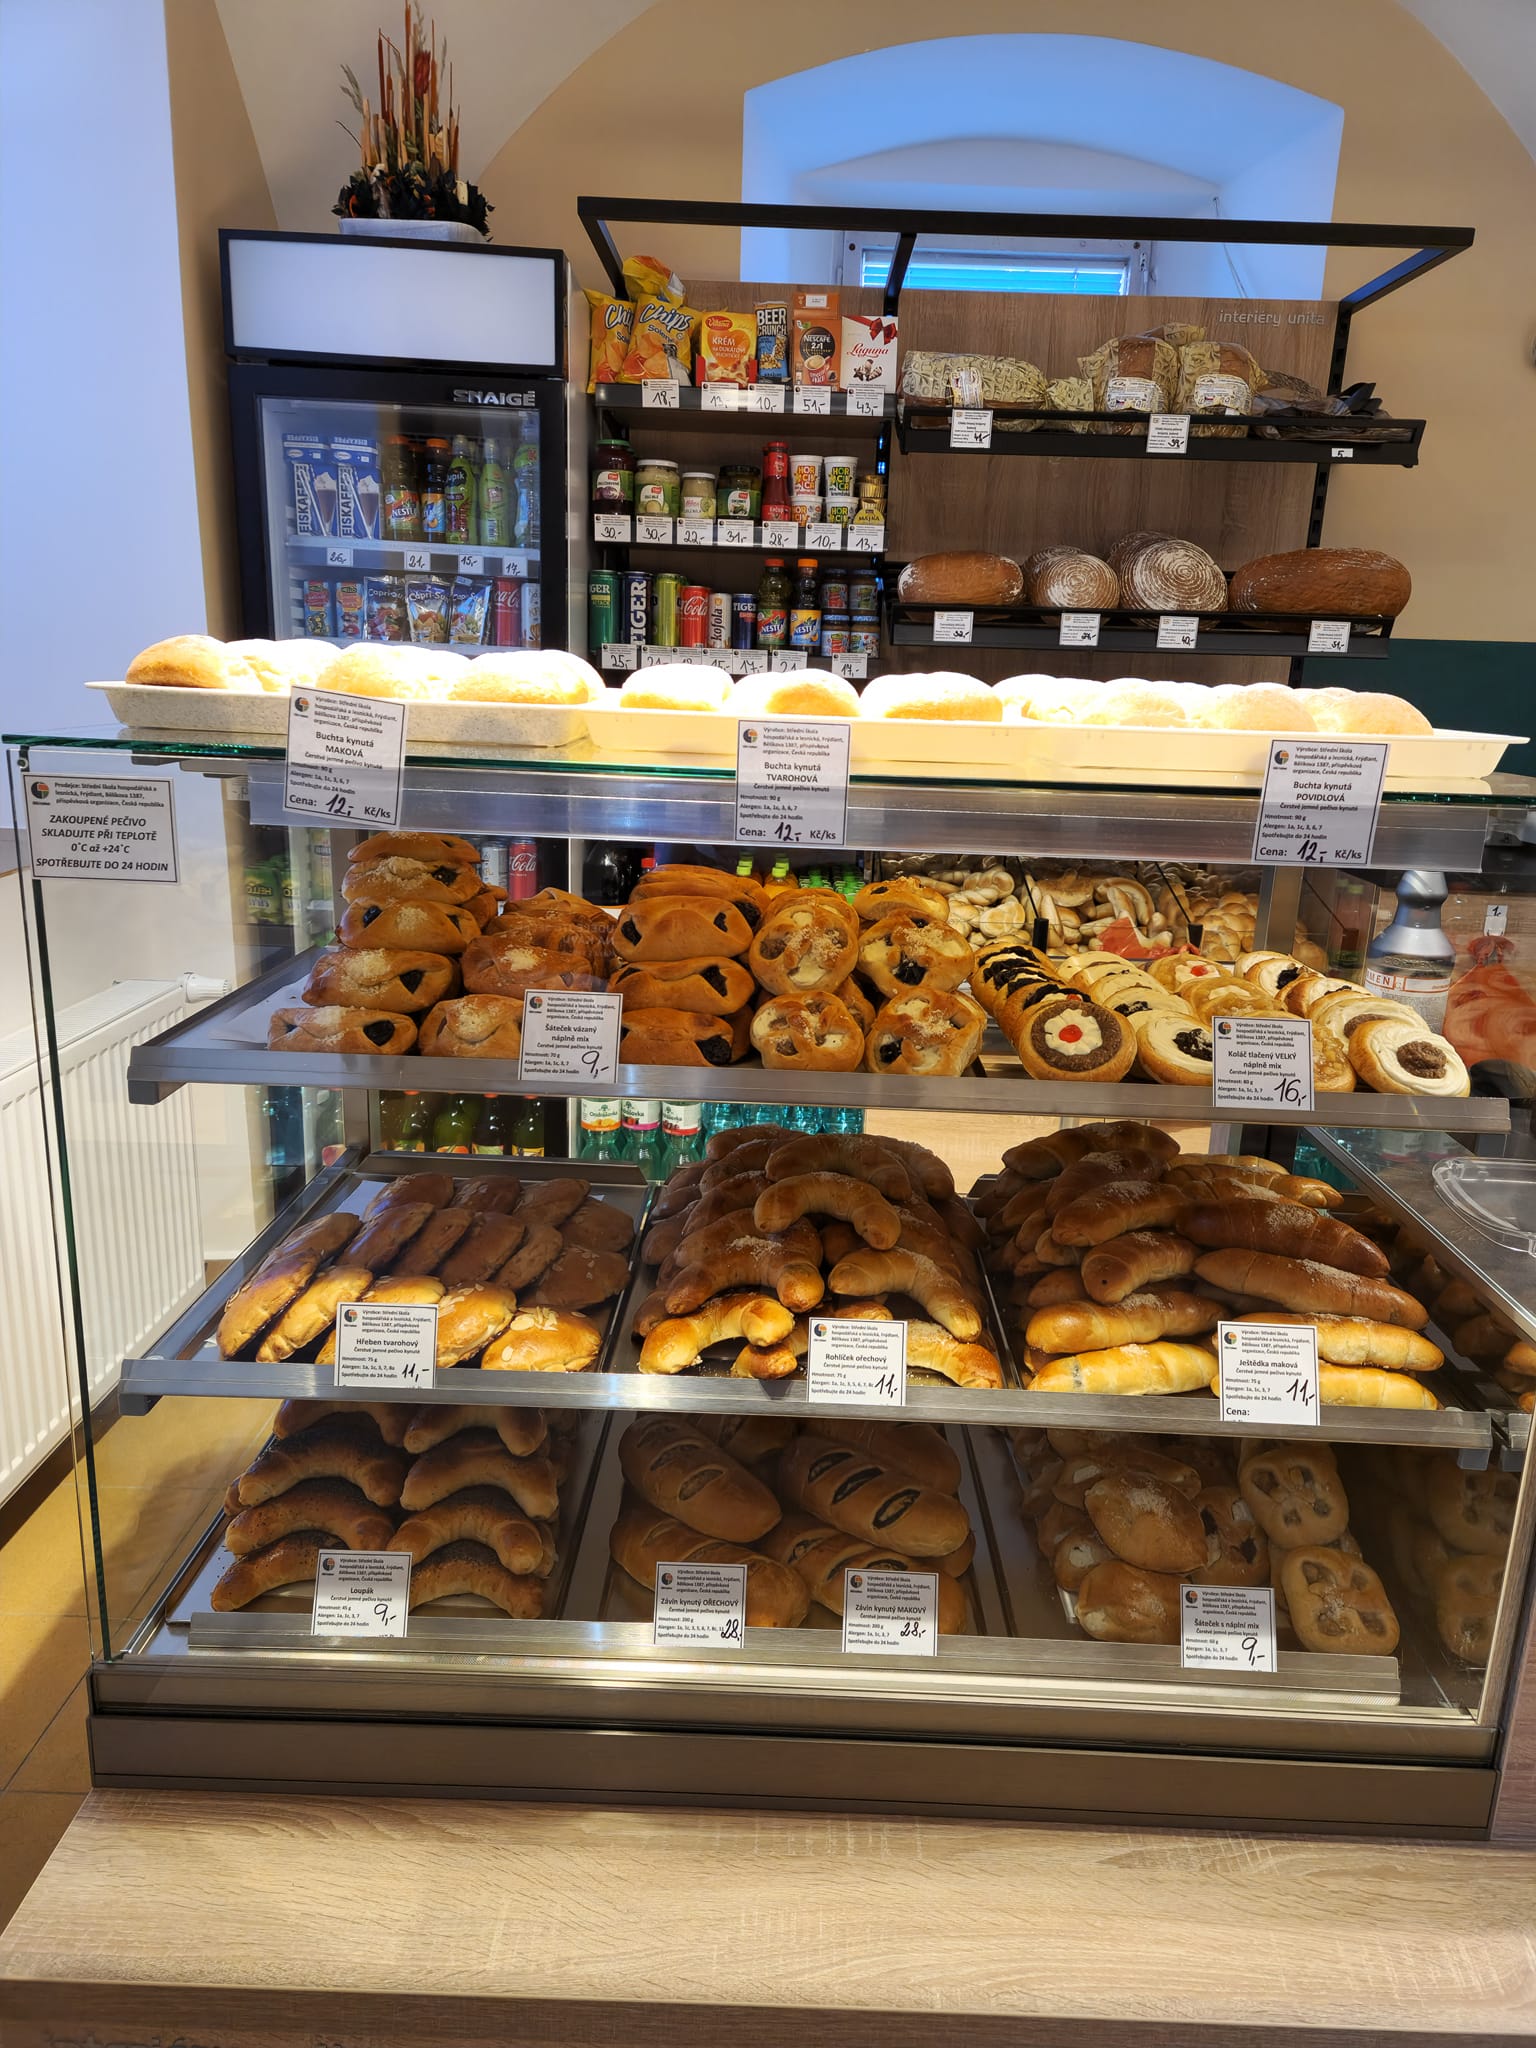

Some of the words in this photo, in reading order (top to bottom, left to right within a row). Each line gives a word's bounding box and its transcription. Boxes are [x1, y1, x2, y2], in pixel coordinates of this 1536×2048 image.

[640, 304, 694, 332] Chips
[757, 308, 786, 325] BEER
[1219, 310, 1280, 326] interiéry
[1288, 313, 1324, 324] unita
[758, 325, 786, 336] CRUNCH
[712, 336, 736, 346] KRÉM
[847, 343, 889, 357] Laguna
[803, 399, 826, 413] 51,-
[856, 401, 878, 416] 43,-
[769, 533, 789, 547] 28,-
[812, 535, 836, 548] 10,-
[856, 538, 878, 551] 13,-
[711, 608, 723, 641] kofola
[611, 655, 632, 670] 25,-
[316, 731, 344, 743] Buchta
[346, 736, 374, 748] kynutá
[325, 745, 364, 758] MAKOVÁ
[764, 762, 792, 770] Buchta
[794, 763, 821, 771] kynutá
[766, 773, 818, 783] TVAROHOVÁ
[1293, 781, 1322, 789] Buchta
[1324, 782, 1352, 792] kynutá
[1296, 793, 1345, 802] POVIDLOVÁ
[289, 794, 317, 806] Cena:
[364, 805, 391, 818] Kč/ks
[49, 814, 108, 826] ZAKOUPENÉ
[111, 816, 146, 826] PEČIVO
[42, 828, 95, 839] SKLADUJTE
[97, 829, 113, 839] PŘI
[116, 831, 157, 840] TEPLOTĚ
[739, 827, 766, 837] Cena:
[810, 830, 836, 840] Kč/ks
[89, 844, 100, 853] až
[1260, 847, 1287, 856] Cena:
[1335, 849, 1362, 860] Kč/ks
[36, 858, 102, 869] SPOTŘEBUJTE
[104, 861, 119, 869] DO
[121, 862, 133, 870] 24
[136, 862, 168, 871] HODIN
[545, 1024, 572, 1032] Šáteček
[573, 1026, 597, 1034] vázaný
[1248, 1051, 1274, 1060] tlačený
[1275, 1052, 1297, 1060] VELKÝ
[1274, 1078, 1307, 1106] 16,-
[383, 1339, 419, 1347] tvarohový
[856, 1355, 887, 1364] ořechový
[402, 1363, 430, 1382] 11,-
[875, 1373, 898, 1398] 11,-
[1286, 1379, 1315, 1406] 11,-
[1226, 1407, 1250, 1416] Cena:
[350, 1587, 374, 1595] Loupák
[703, 1599, 739, 1607] OŘECHOVÝ
[874, 1605, 896, 1613] kynutý
[897, 1606, 927, 1614] MAKOVÝ
[374, 1603, 397, 1626] 9,-
[1194, 1618, 1219, 1627] Šáteček
[1225, 1621, 1246, 1629] náplní
[1242, 1637, 1265, 1666] 9,-
